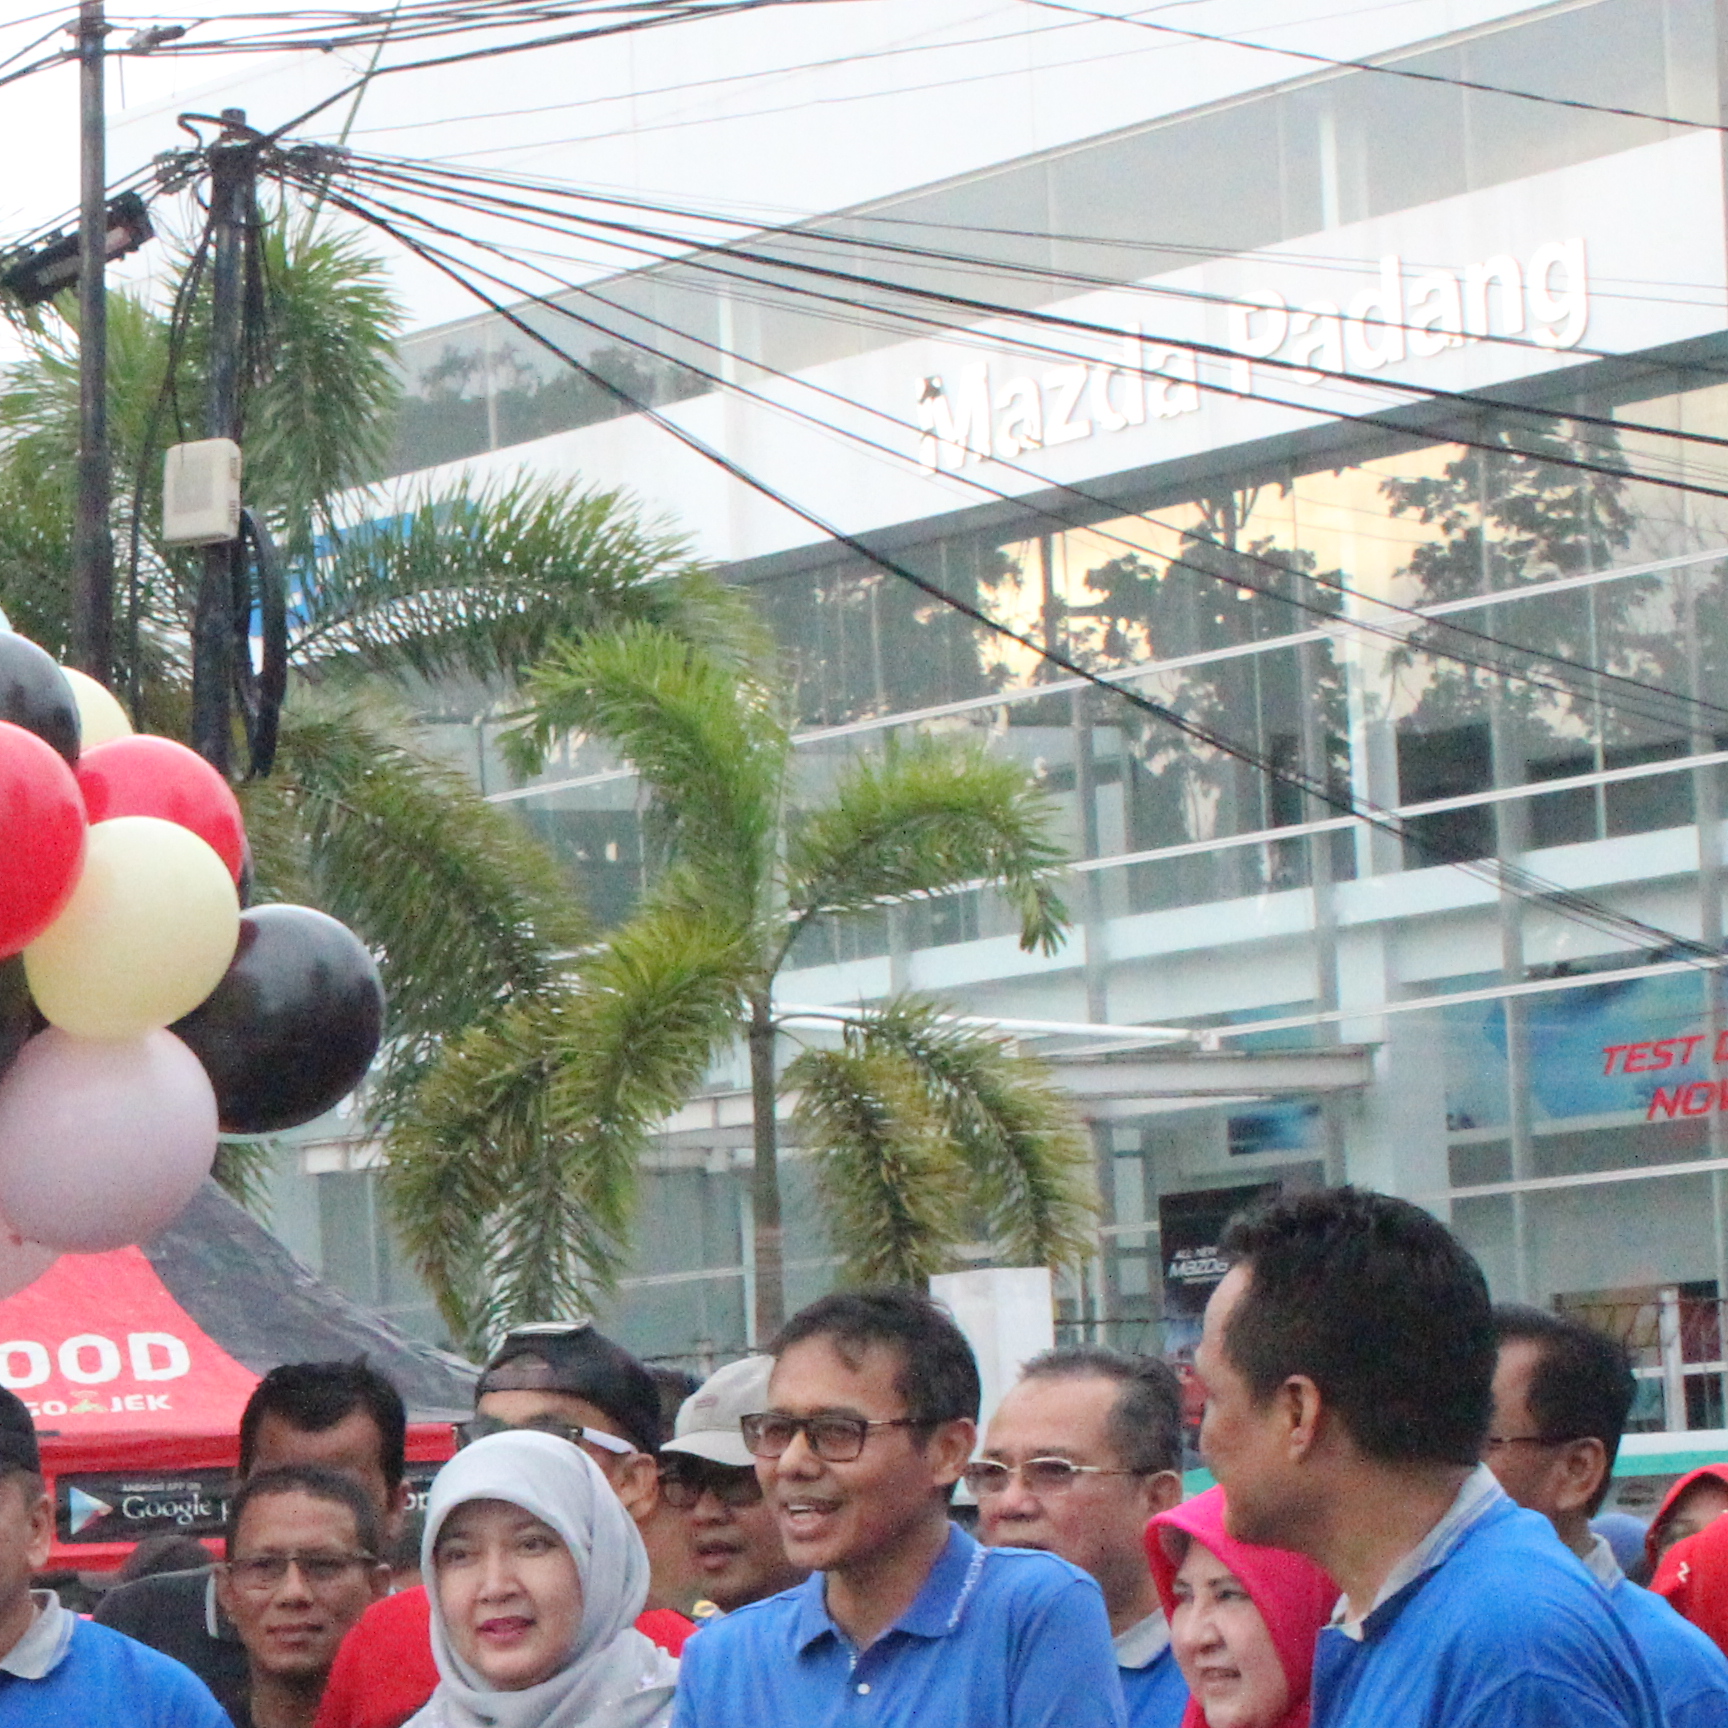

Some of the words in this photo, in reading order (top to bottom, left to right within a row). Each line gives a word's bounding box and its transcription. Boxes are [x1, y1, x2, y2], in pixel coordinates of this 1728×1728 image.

[915, 321, 1200, 476] Mazda
[1228, 238, 1589, 397] Padang
[1603, 1034, 1706, 1076] TEST
[122, 1492, 212, 1526] Google
